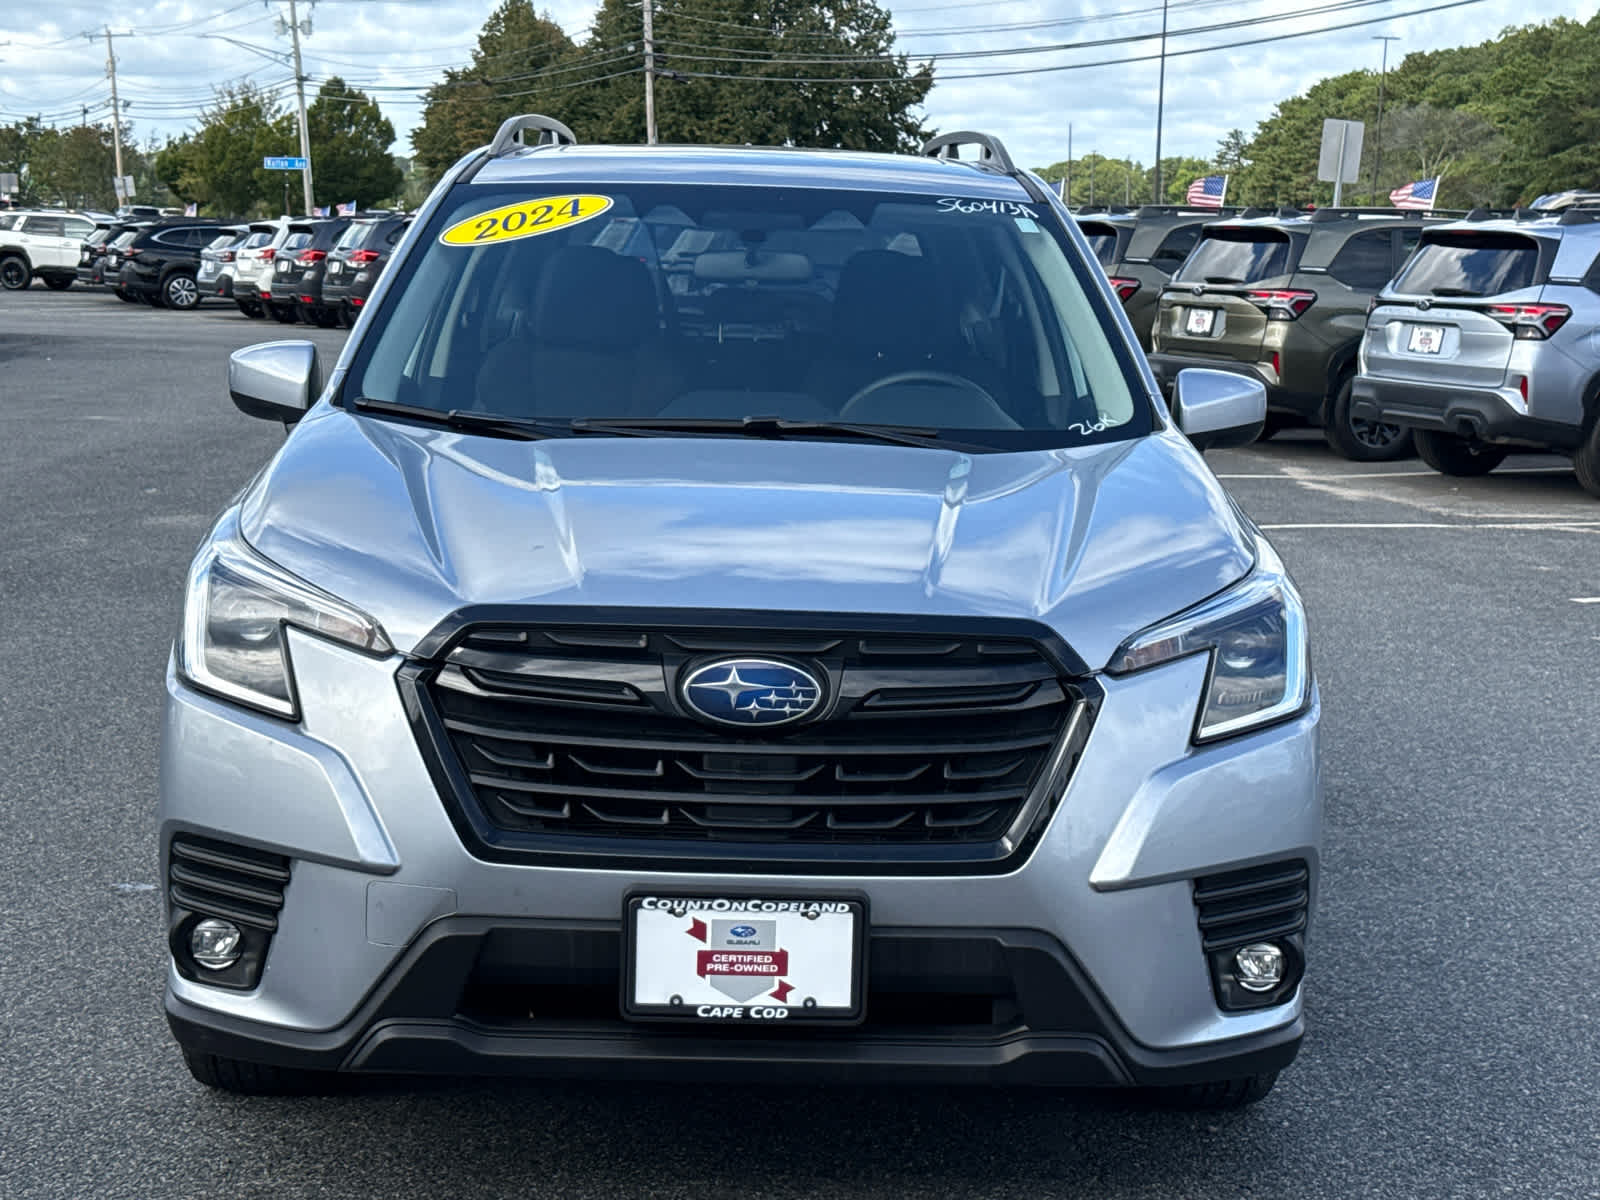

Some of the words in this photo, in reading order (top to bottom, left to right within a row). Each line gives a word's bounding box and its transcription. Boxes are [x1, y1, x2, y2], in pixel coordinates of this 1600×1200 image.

[474, 198, 583, 240] 2024
[712, 954, 773, 963] CERTIFIED
[706, 963, 778, 973] PRE-OWNED
[697, 1005, 744, 1018] CAPE
[750, 1006, 788, 1019] COD
